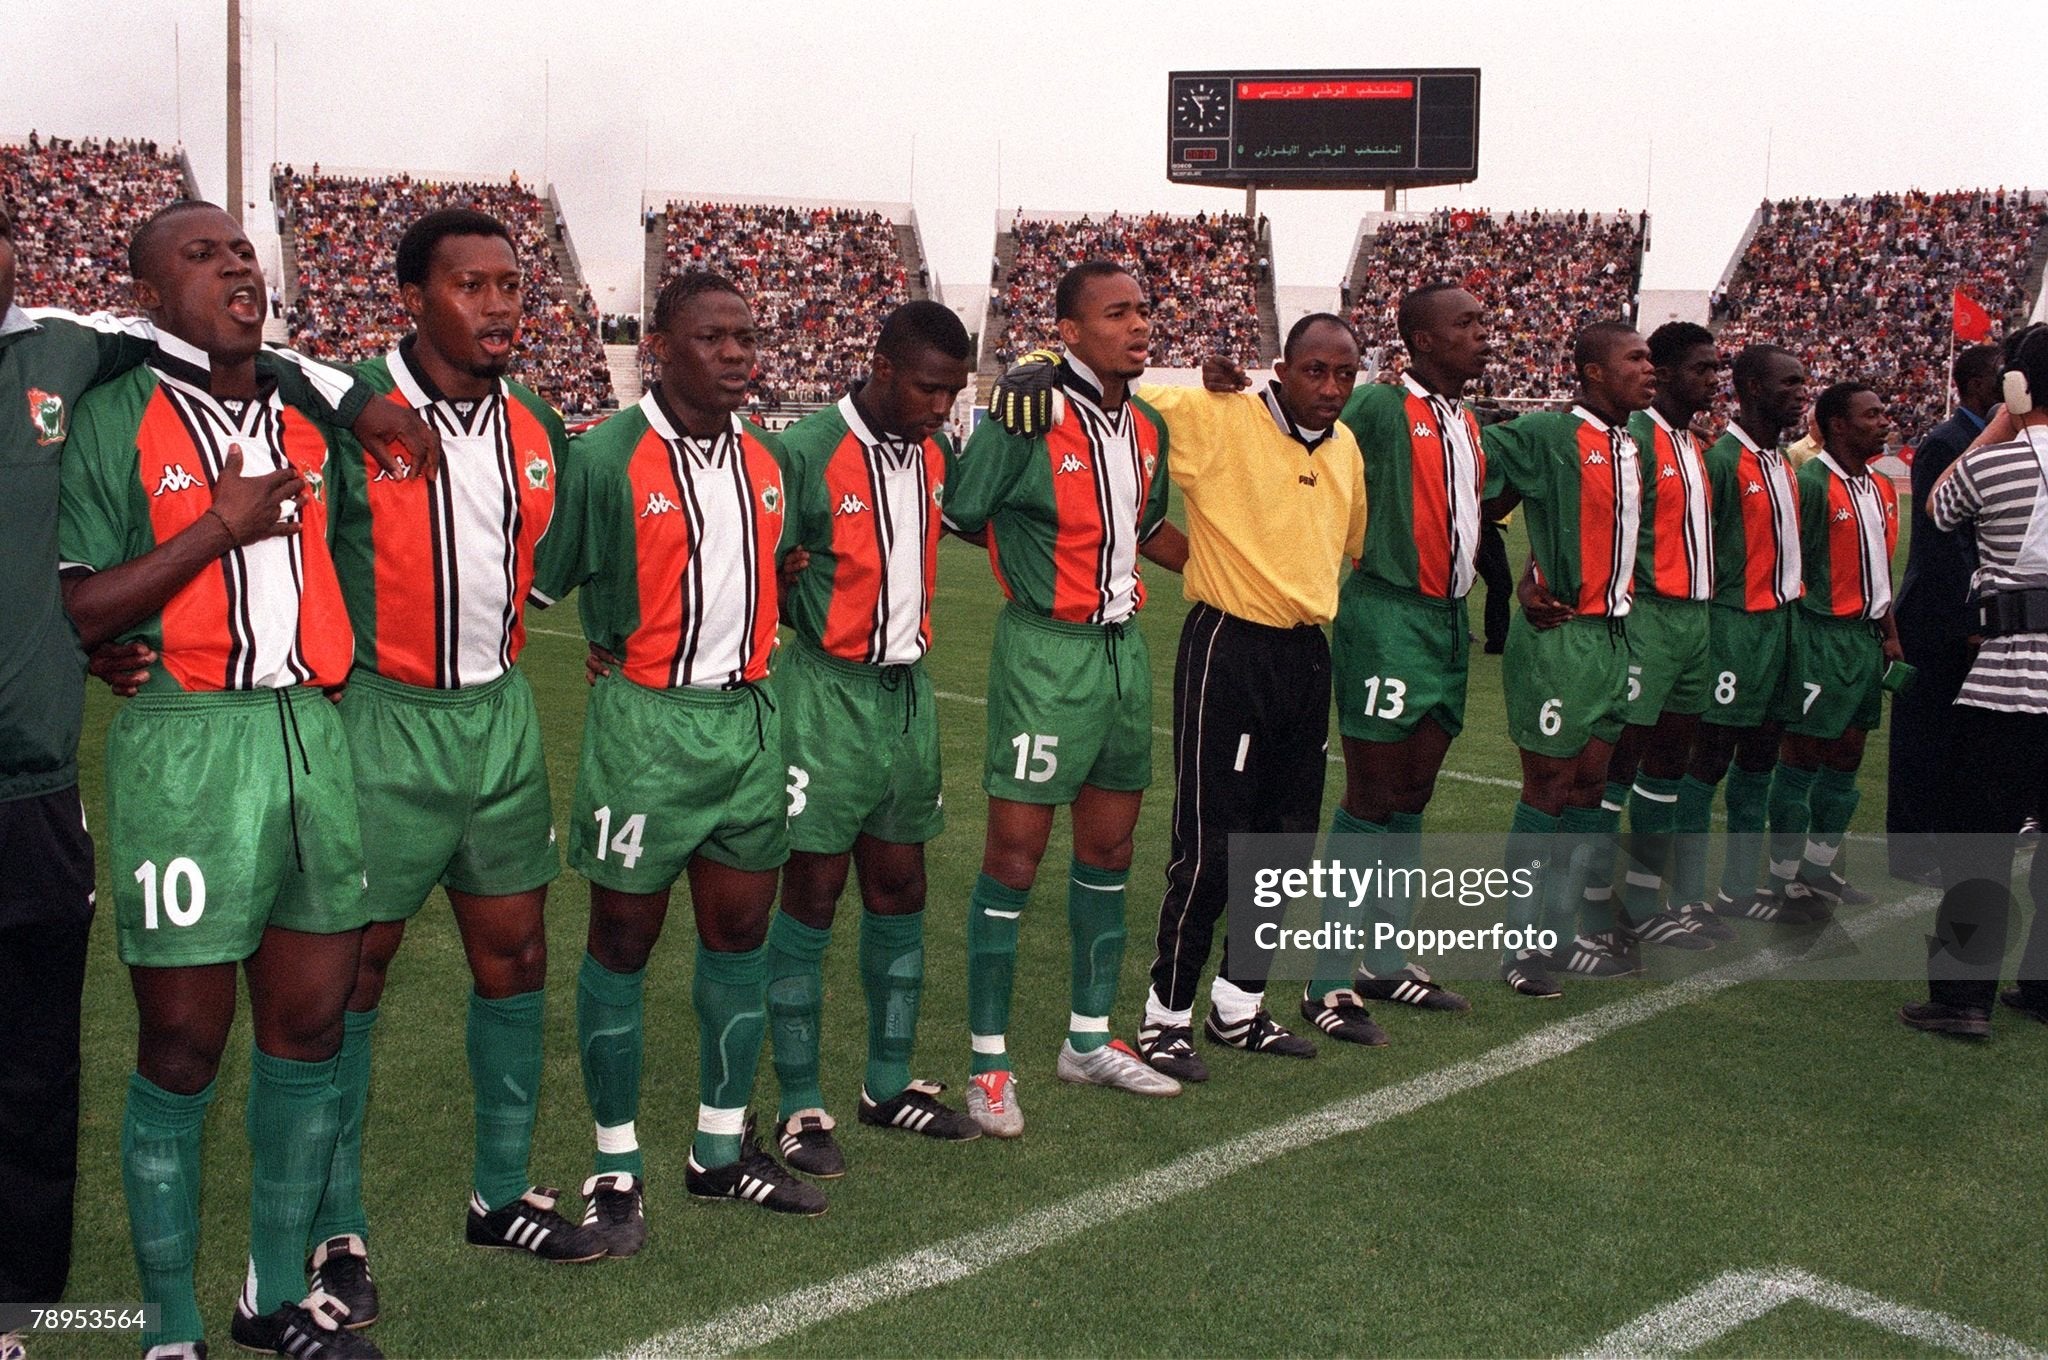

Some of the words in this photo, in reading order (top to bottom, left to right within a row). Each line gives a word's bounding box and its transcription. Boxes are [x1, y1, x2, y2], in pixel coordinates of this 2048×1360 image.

[1308, 143, 1346, 157] الوطني
[1353, 144, 1402, 156] المنتخب
[1363, 674, 1407, 720] 13
[1714, 671, 1737, 705] 8
[1803, 682, 1821, 715] 7
[1539, 697, 1563, 736] 6
[1011, 732, 1059, 784] 15
[593, 805, 647, 870] 14
[134, 855, 207, 931] 10
